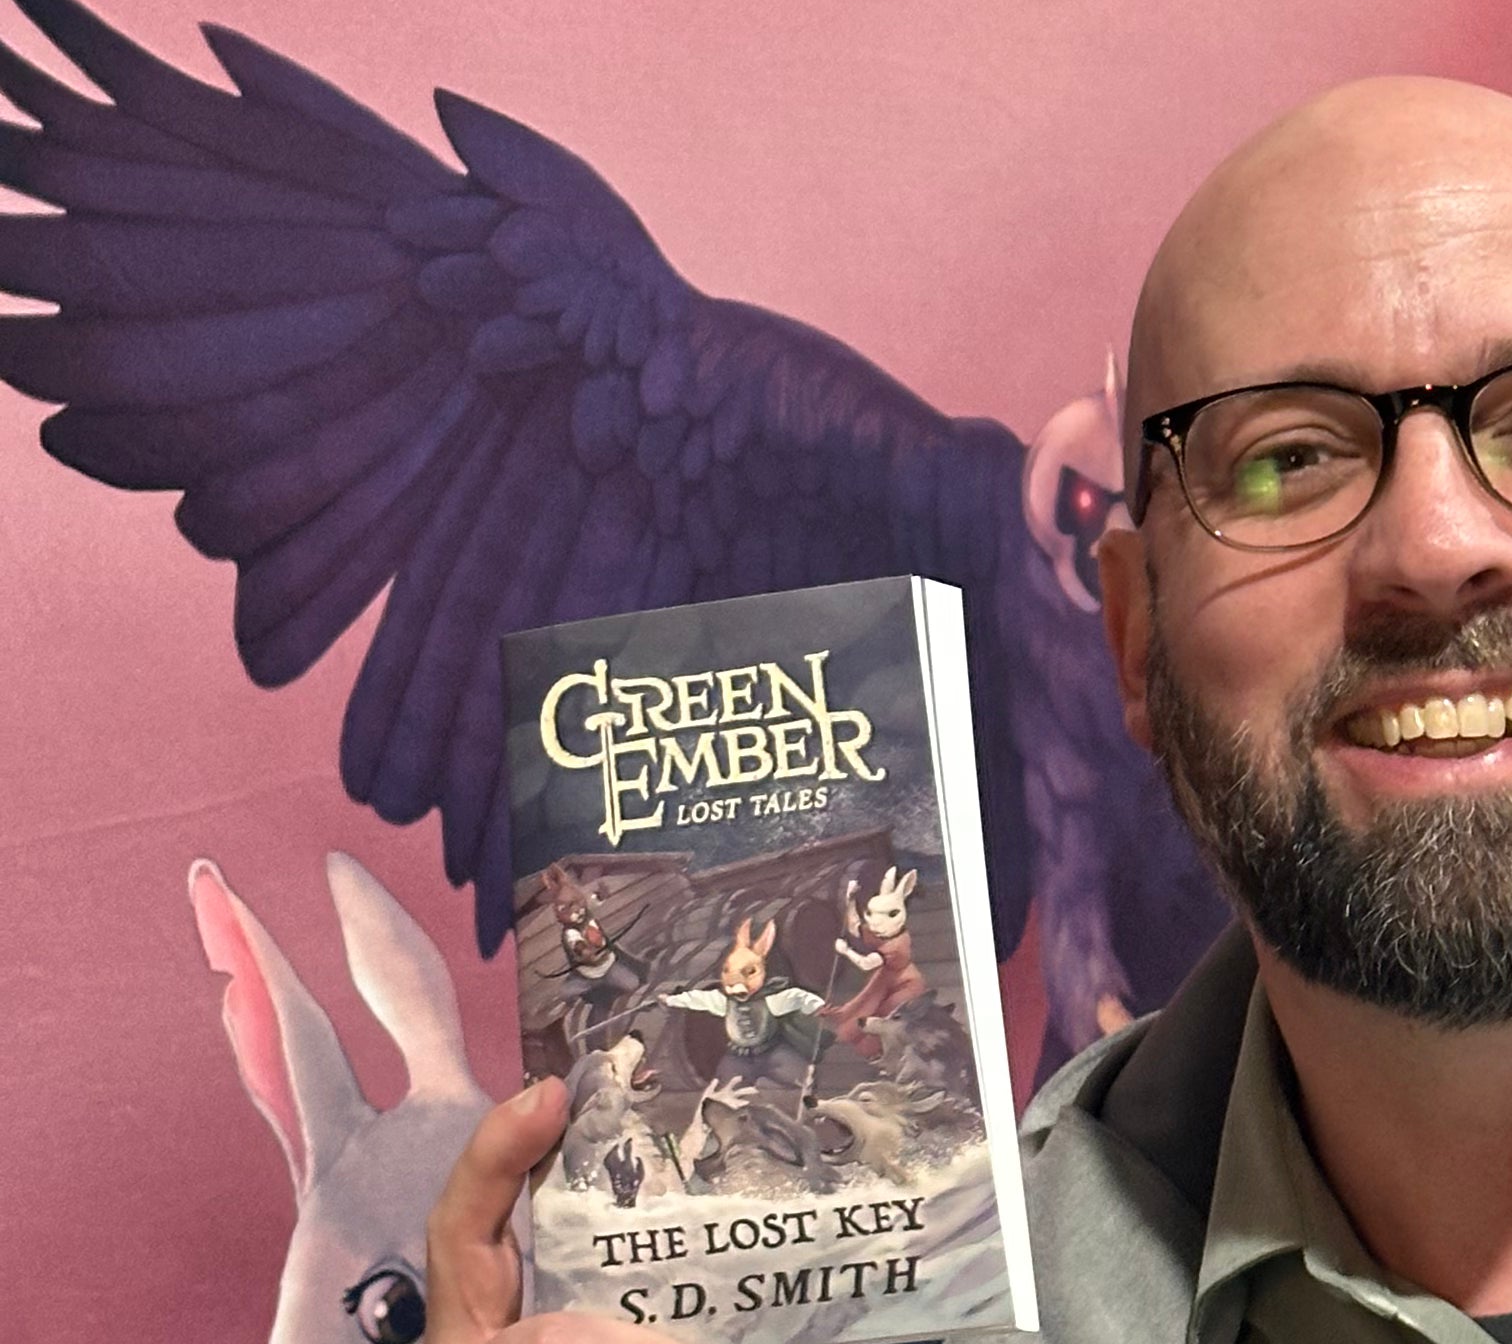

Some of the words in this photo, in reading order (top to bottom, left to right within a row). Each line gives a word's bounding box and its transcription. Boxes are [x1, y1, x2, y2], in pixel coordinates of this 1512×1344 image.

[540, 650, 830, 769] GREEN
[598, 710, 886, 847] EMBER
[676, 800, 742, 826] LOST
[750, 786, 830, 818] TALES
[593, 1225, 690, 1269] THE
[703, 1208, 818, 1256] LOST
[833, 1197, 926, 1240] KEY
[620, 1288, 657, 1326] S.
[671, 1282, 717, 1321] D.
[733, 1255, 924, 1313] SMITH
